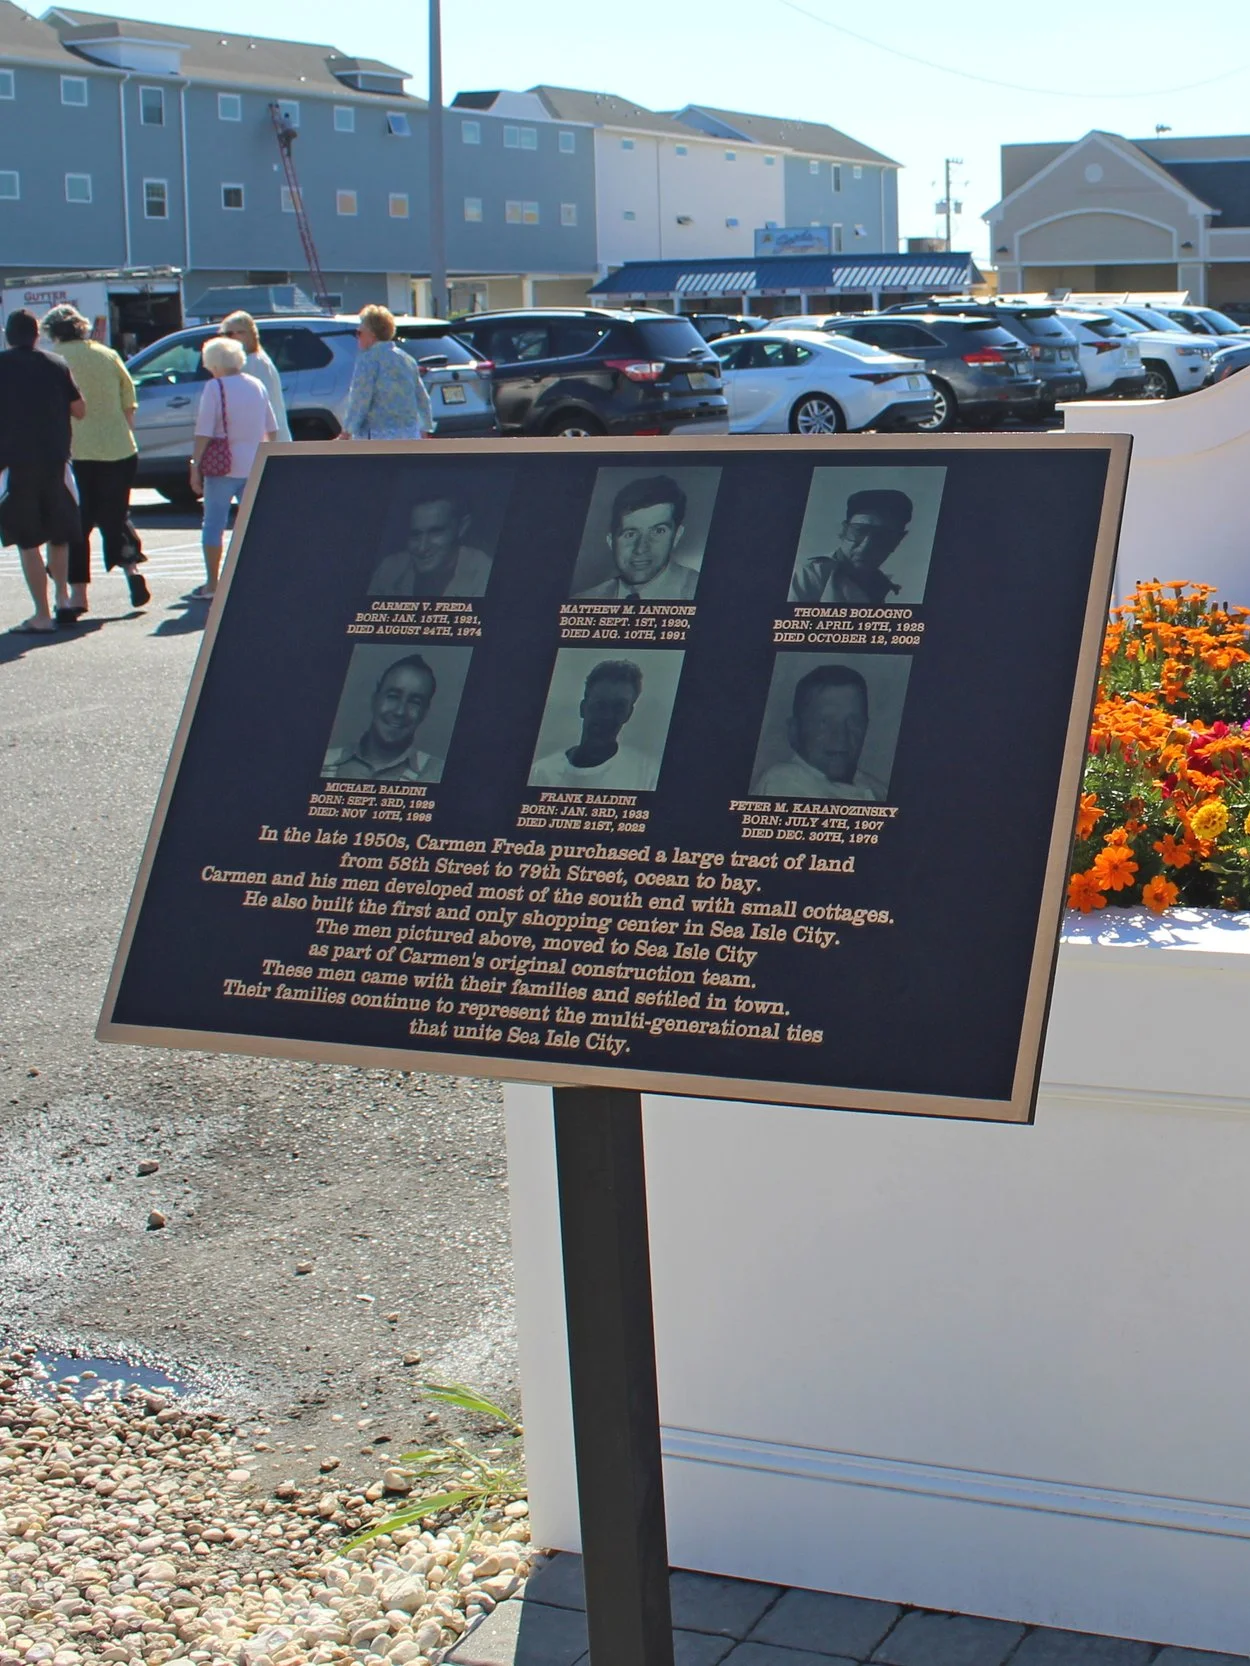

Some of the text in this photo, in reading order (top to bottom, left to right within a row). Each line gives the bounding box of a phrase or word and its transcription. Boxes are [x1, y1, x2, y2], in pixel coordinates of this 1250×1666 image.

[372, 602, 473, 612] CARMEN V. FREDA
[560, 605, 697, 615] MATTHEW M. IANNONE
[794, 608, 913, 619] THOMAS BOLOGNO
[355, 613, 481, 625] BORN: JAN. 15TH, 1921,
[559, 617, 691, 629] BORN: SEPT. 1ST, 1920,
[773, 620, 925, 632] BORN: APRIL 19TH, 1928
[347, 625, 375, 634] DIED
[376, 625, 422, 635] AUGUST
[423, 627, 454, 636] 24TH,
[561, 629, 591, 638] DIED
[592, 629, 621, 639] AUG.
[624, 630, 656, 640] 10TH,
[773, 633, 921, 645] DIED OCTOBER 12, 2002
[325, 783, 428, 796] MICHAEL BALDINI
[310, 794, 345, 805] BORN:
[347, 796, 378, 806] SEPT.
[381, 798, 406, 809] 3RD,
[540, 793, 637, 806] FRANK BALDINI
[308, 806, 339, 817] DIED:
[341, 808, 368, 818] NOV
[372, 811, 403, 822] 10TH,
[521, 804, 650, 820] BORN: JAN. 3RD, 1933
[729, 800, 899, 818] PETER M. KARANOZINSKY
[517, 817, 646, 832] DIED JUNE 21ST, 2022
[742, 815, 885, 830] BORN: JULY 4TH, 1907
[741, 828, 879, 844] DIED DEC. 30TH, 1976
[259, 825, 855, 873] In the late 1950s, Carmen Freda purchased a large tract of land
[340, 852, 761, 895] from 58th Street to 79th Street, ocean to bay.
[202, 866, 894, 926] Carmen and his men developed most of the south end with small cottages.
[243, 890, 840, 949] He also built the first and only shopping center in Sea Isle City.
[316, 918, 758, 968] The men pictured above, moved to Sea Isle City
[309, 944, 756, 987] as part of Carmen's original construction team.
[263, 959, 790, 1015] These men came with their families and settled in town.
[224, 979, 824, 1043] Their families continue to represent the multi-generational ties
[410, 1019, 630, 1056] that unite Sea Isle City.
